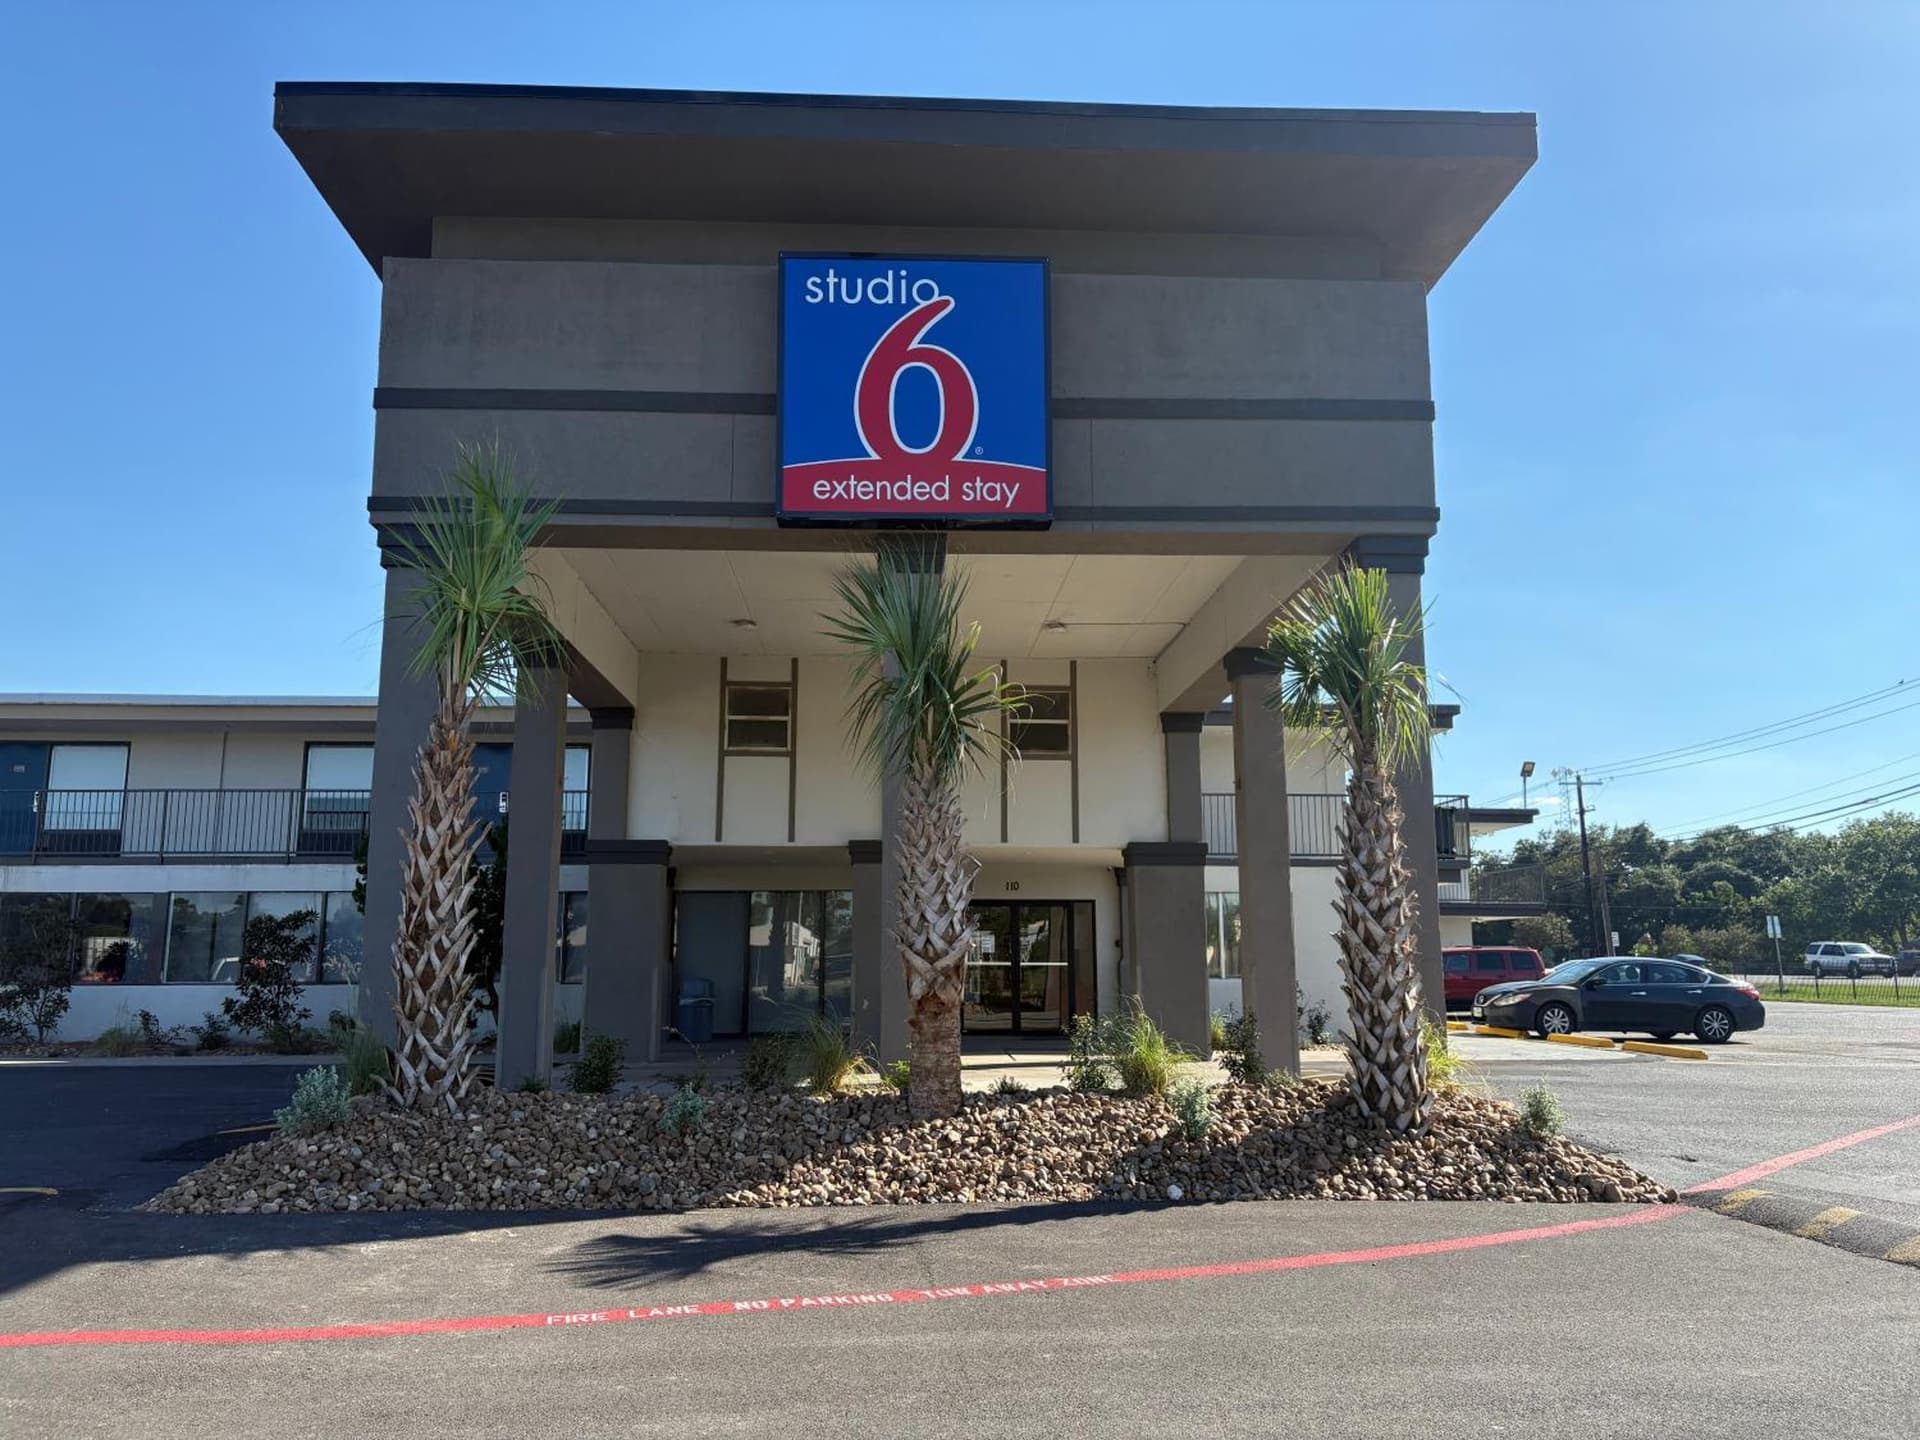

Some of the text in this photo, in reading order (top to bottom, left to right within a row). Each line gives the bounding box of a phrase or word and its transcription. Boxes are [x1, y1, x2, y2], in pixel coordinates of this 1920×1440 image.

[805, 269, 940, 305] studio
[854, 295, 980, 461] 6
[812, 474, 1020, 508] extended stay
[546, 1274, 1115, 1326] FIRE LANE NO PARKING TOW AWAY ZONE
